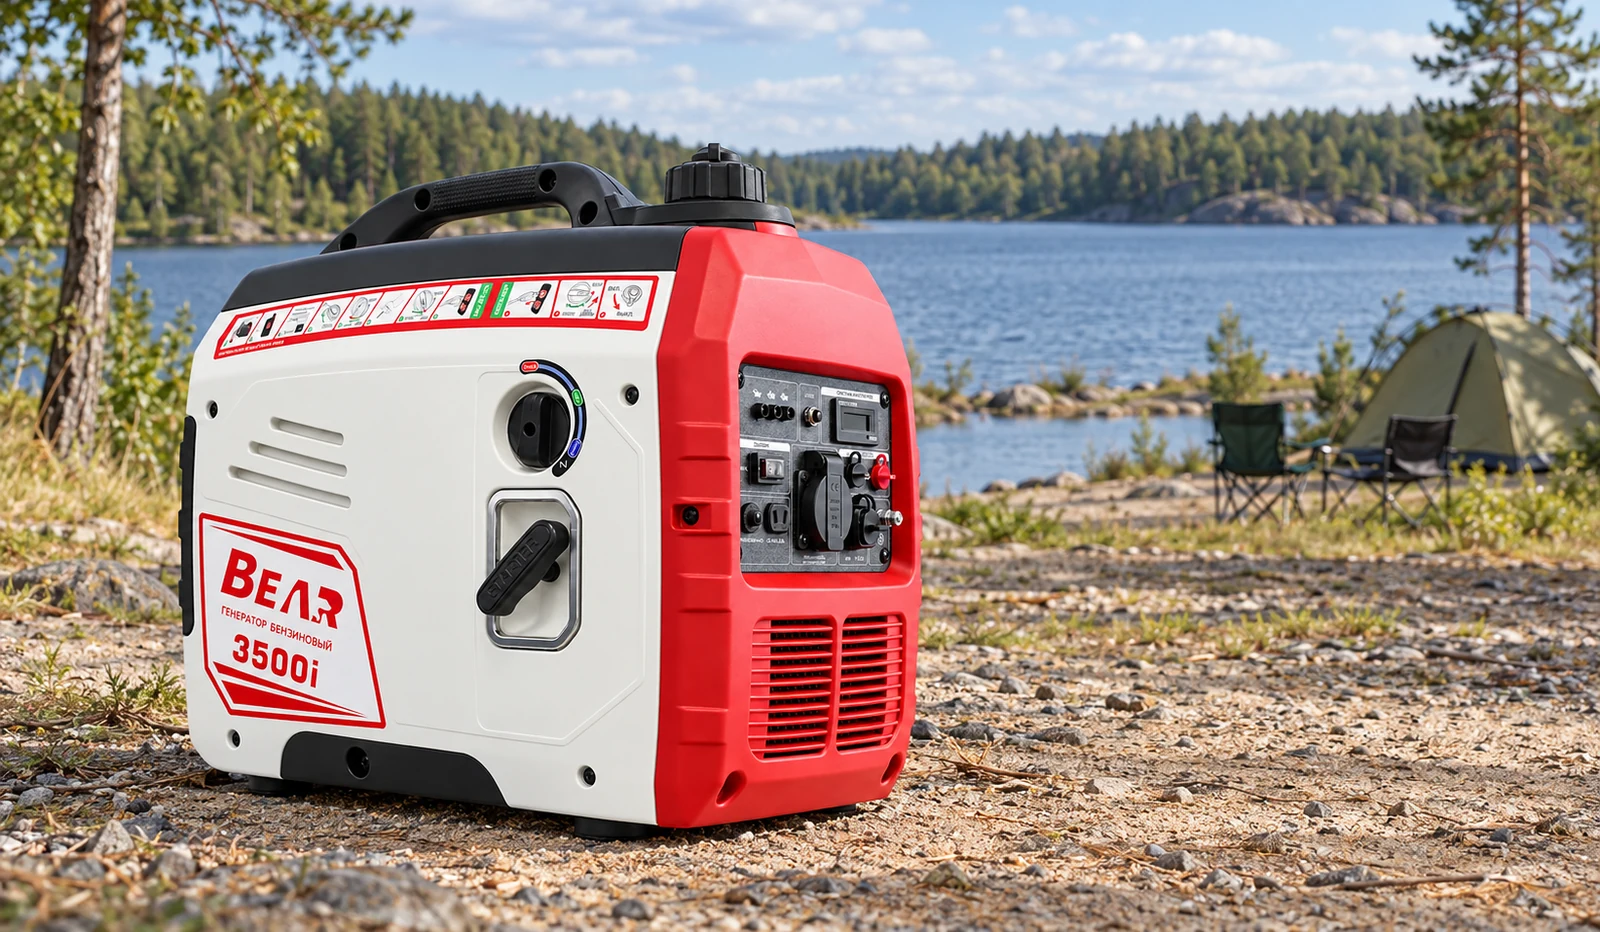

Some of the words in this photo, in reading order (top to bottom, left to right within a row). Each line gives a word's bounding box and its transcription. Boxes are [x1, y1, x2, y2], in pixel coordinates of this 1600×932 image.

[220, 547, 344, 630] BEAR
[487, 537, 538, 599] STARTER
[221, 605, 268, 629] ГЕНЕРАТОР
[270, 622, 333, 652] БЕНЗИНОВЫЙ
[232, 634, 319, 688] 3500i
